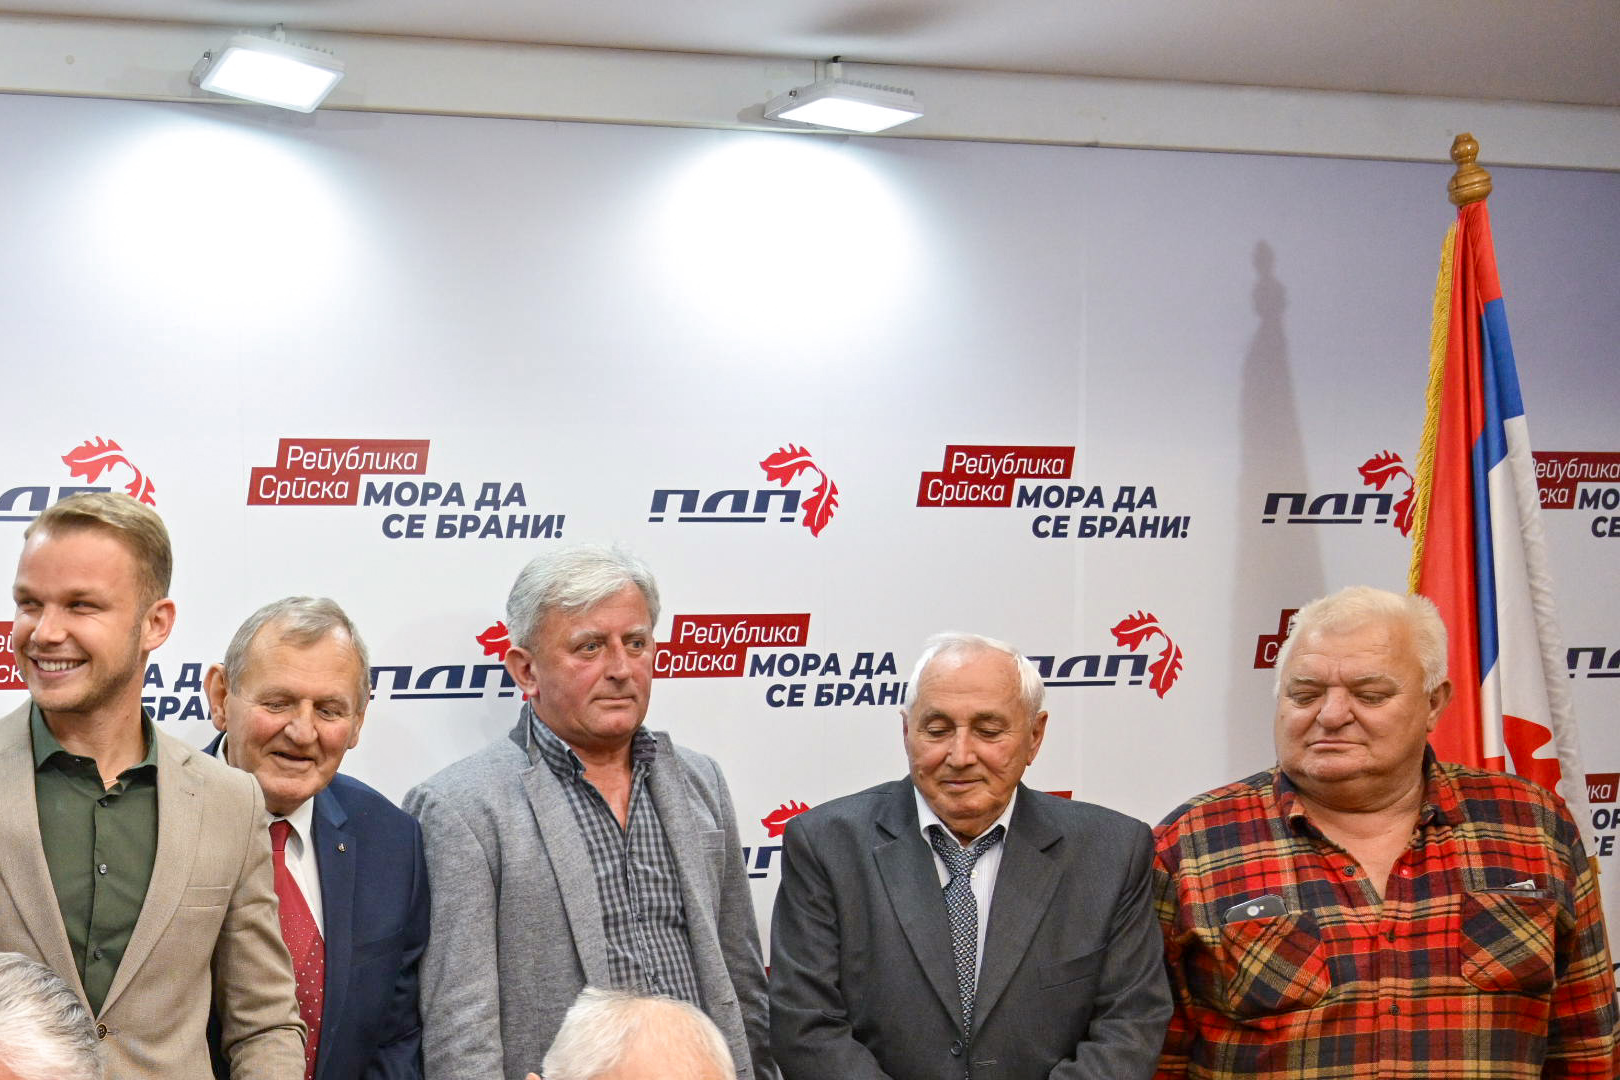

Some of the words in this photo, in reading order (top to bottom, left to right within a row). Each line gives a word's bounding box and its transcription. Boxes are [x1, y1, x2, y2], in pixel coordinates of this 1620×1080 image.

[1532, 457, 1620, 483] епублика
[363, 481, 464, 507] МОРА
[473, 482, 527, 508] ДА
[1016, 485, 1105, 509] МОРА
[1111, 486, 1158, 512] ДА
[1538, 487, 1569, 504] ска
[1579, 488, 1620, 511] МО
[381, 513, 427, 539] СЕ
[435, 514, 566, 539] БРАНИ!
[1031, 514, 1071, 539] СЕ
[1077, 515, 1191, 539] БРАНИ!
[173, 662, 203, 693] Д
[748, 652, 842, 678] МОРА
[849, 652, 897, 680] ДА
[765, 683, 807, 708] СЕ
[813, 681, 908, 707] БРАН
